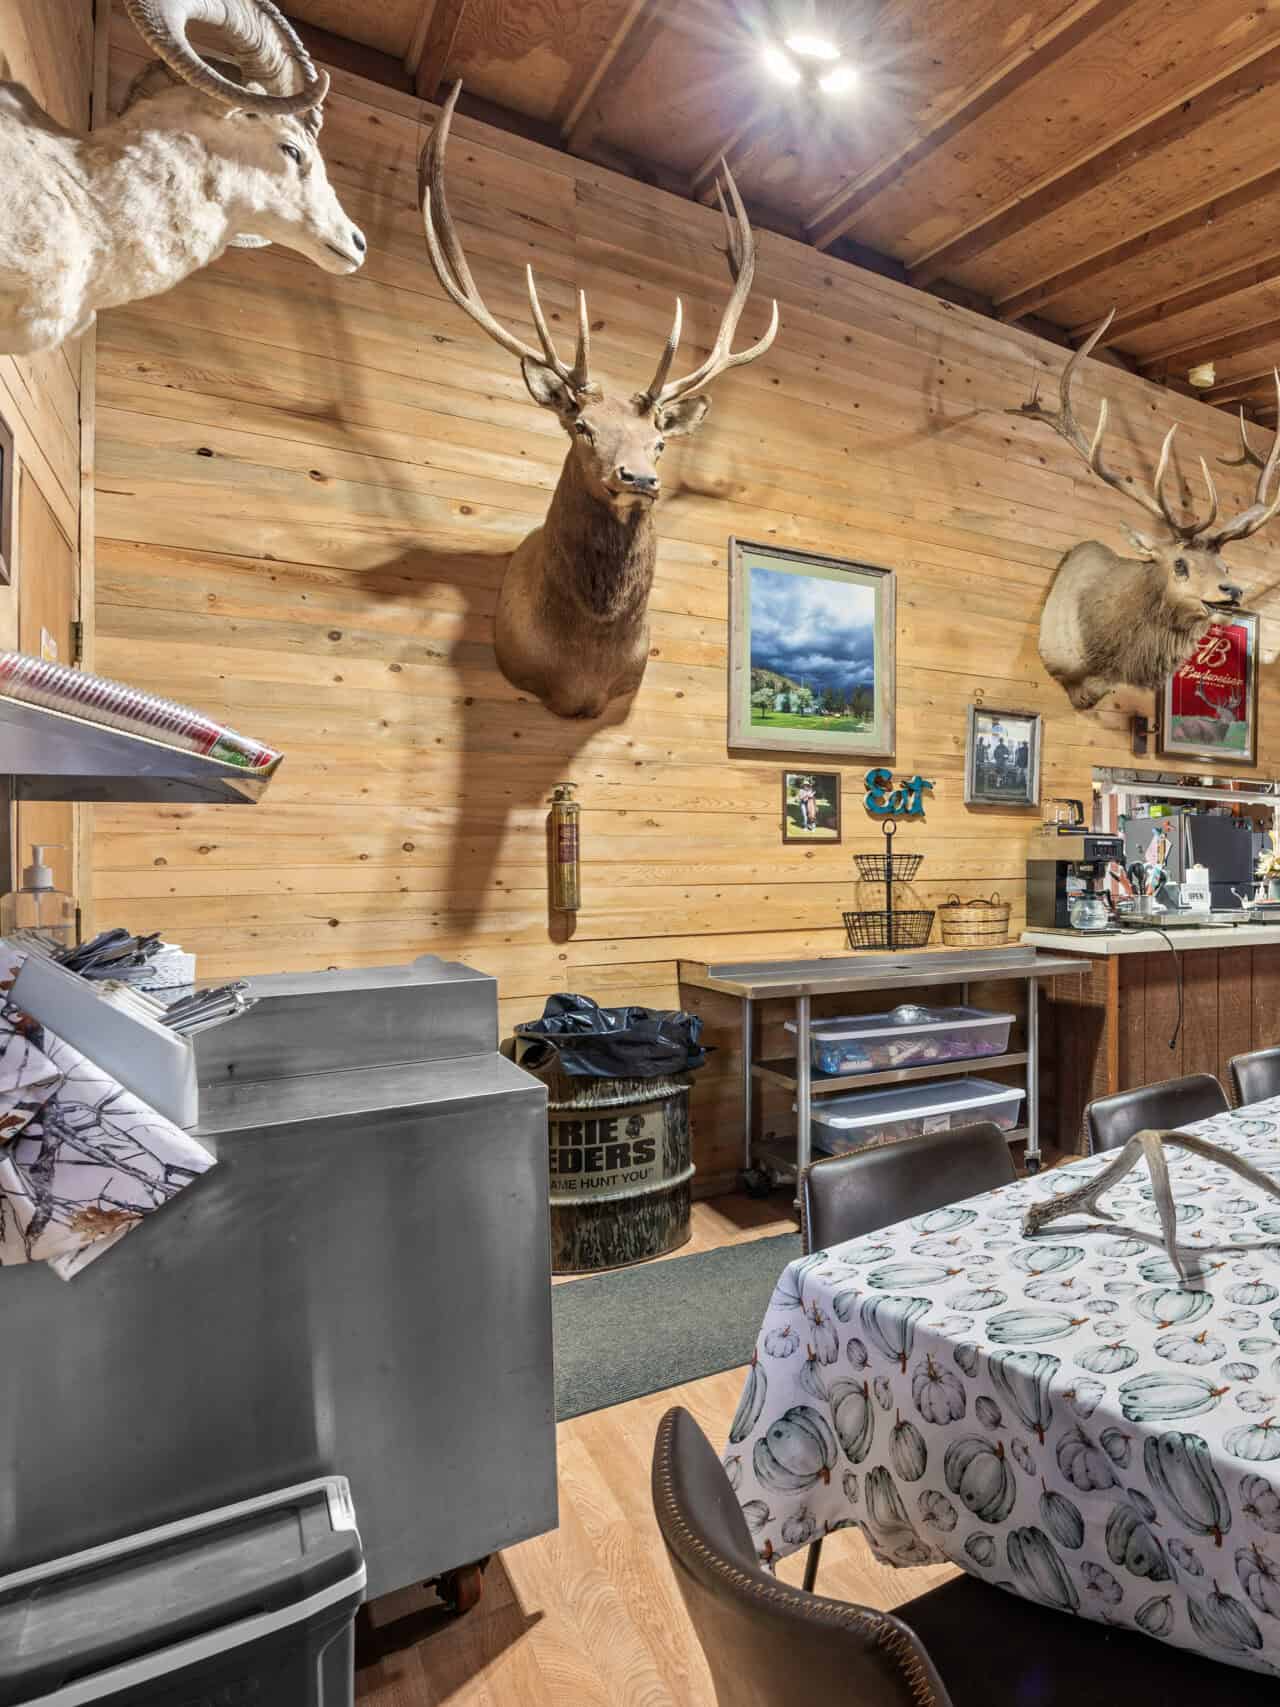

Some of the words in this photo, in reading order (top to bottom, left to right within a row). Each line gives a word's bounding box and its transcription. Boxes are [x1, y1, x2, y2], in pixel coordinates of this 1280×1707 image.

[1179, 664, 1244, 686] Budweiser
[863, 768, 935, 816] Eat
[580, 1174, 618, 1190] HUNT
